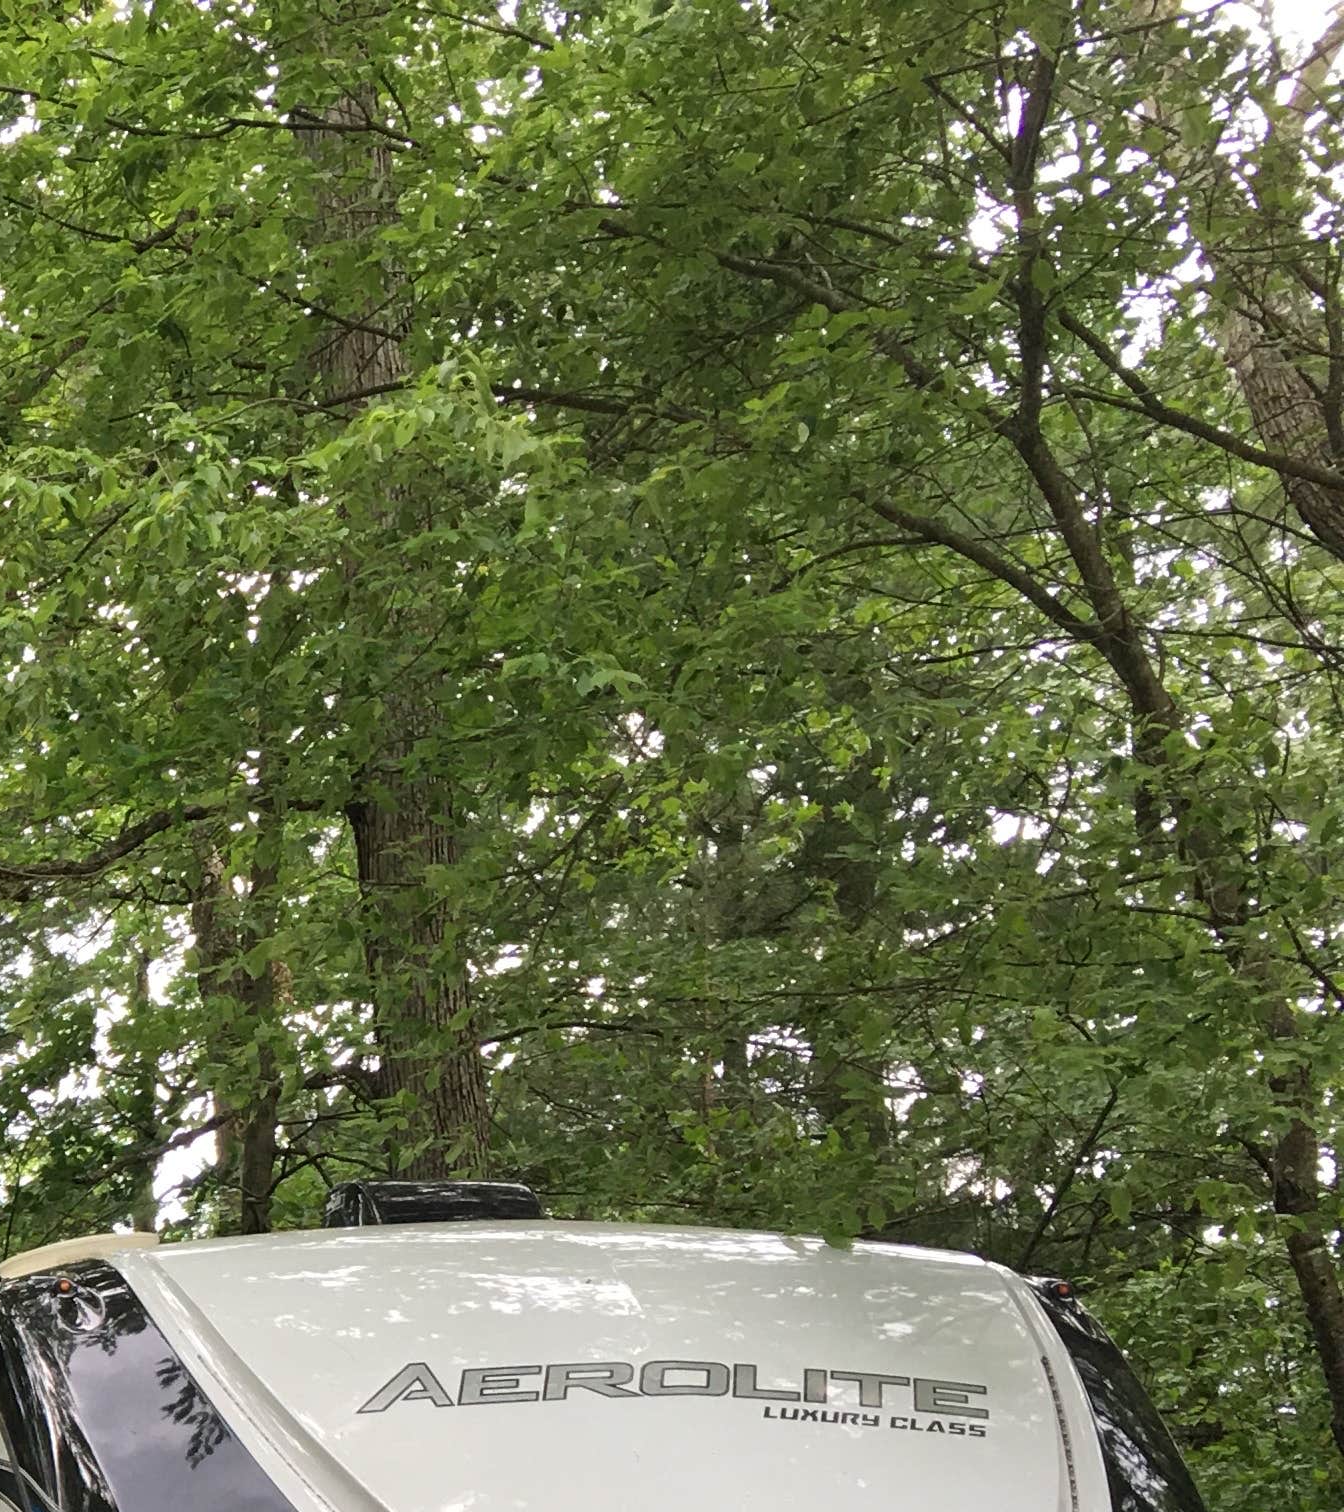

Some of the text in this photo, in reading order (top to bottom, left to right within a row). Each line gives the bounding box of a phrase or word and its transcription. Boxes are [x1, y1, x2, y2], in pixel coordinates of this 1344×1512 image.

[356, 1360, 990, 1420] AEROLITE
[763, 1406, 987, 1438] LUXURY CLASS
